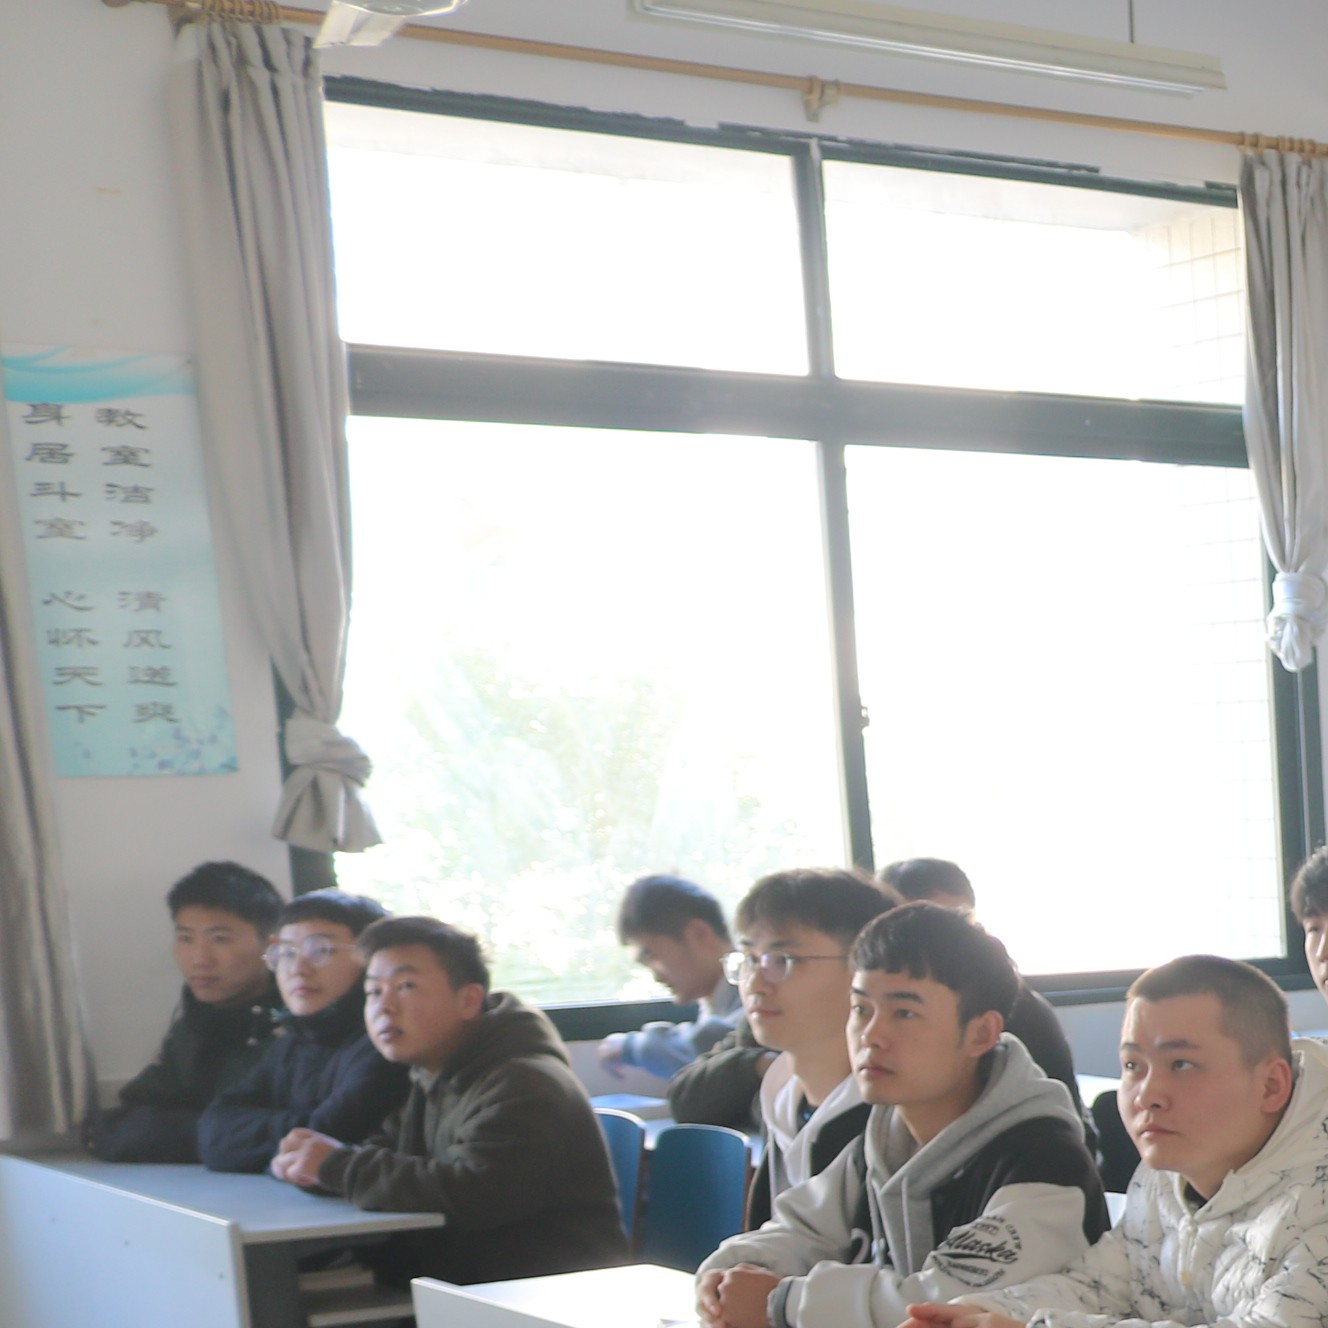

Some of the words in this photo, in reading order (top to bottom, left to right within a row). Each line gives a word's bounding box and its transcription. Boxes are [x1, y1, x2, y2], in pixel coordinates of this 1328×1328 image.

[22, 402, 87, 540] 身居斗室
[96, 407, 159, 543] 教室洁净
[43, 590, 106, 724] 心怀天下
[118, 591, 181, 724] 清风送爽
